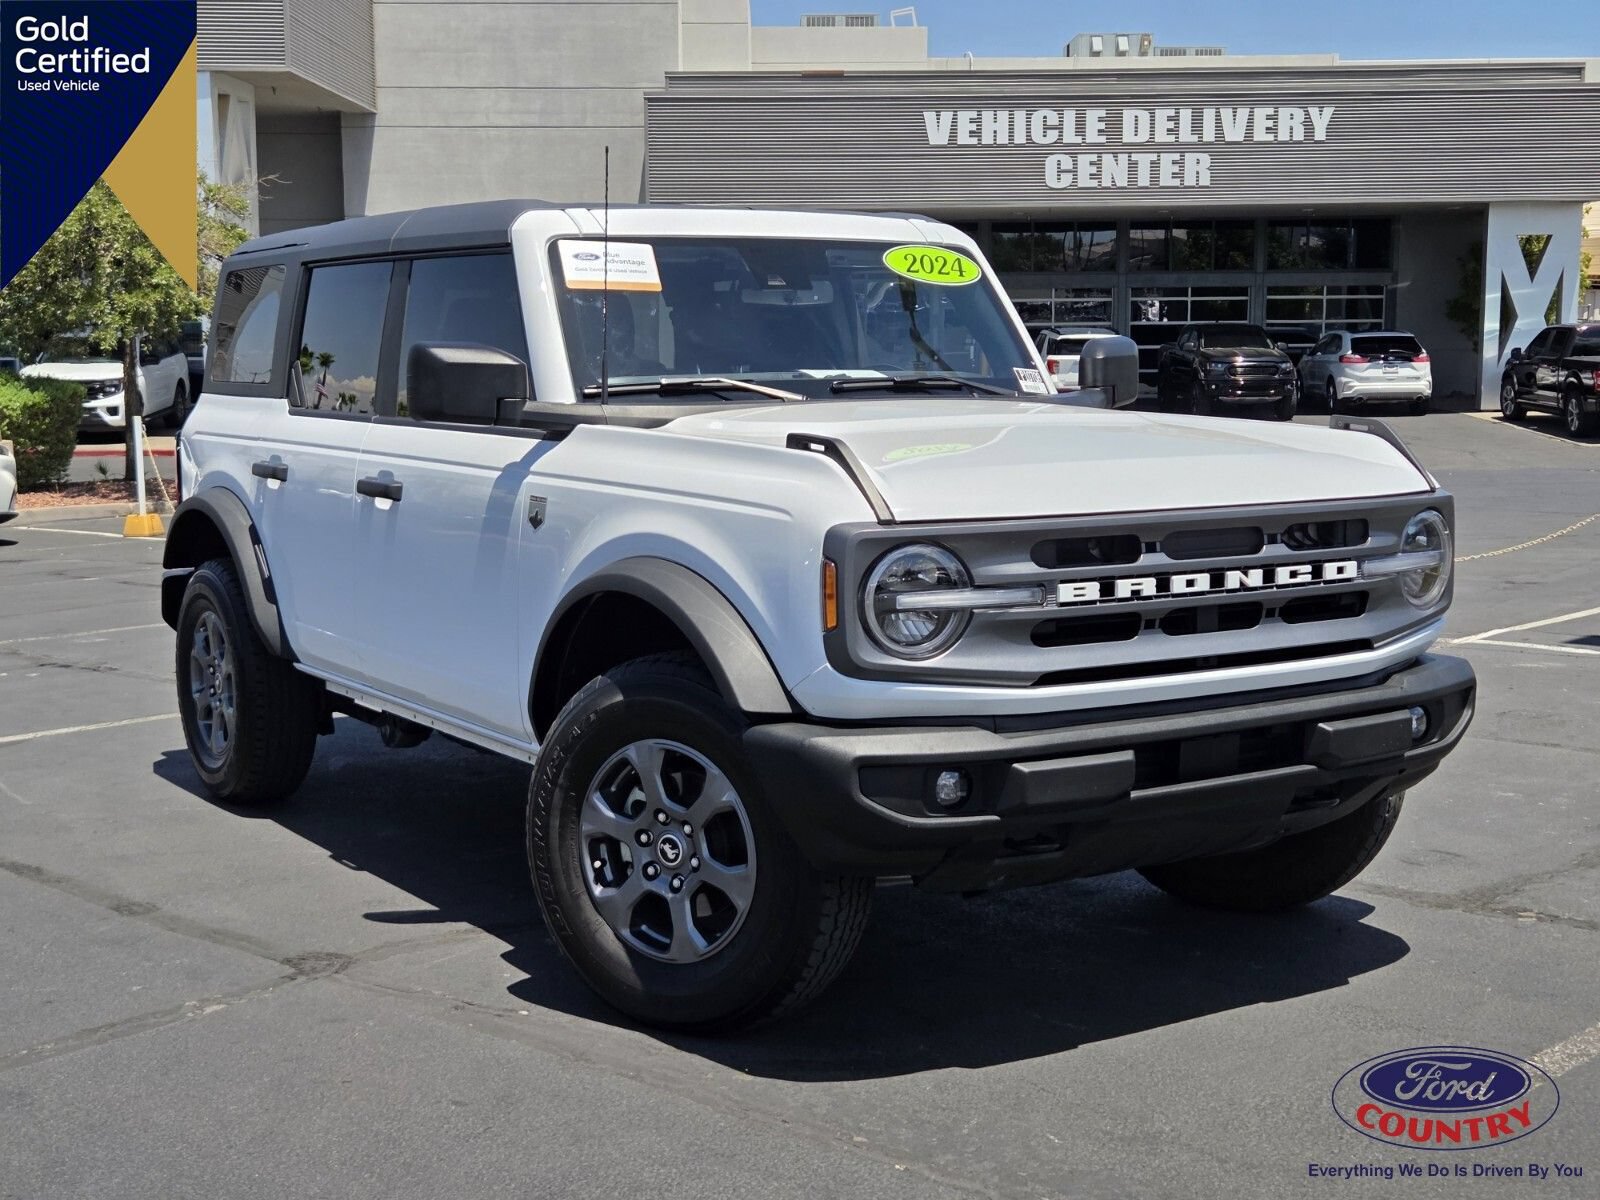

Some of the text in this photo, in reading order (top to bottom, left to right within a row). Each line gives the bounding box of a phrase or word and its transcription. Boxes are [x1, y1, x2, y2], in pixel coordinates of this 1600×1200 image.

[923, 106, 1336, 147] VEHICLE DELIVERY
[1044, 153, 1212, 189] CENTER
[903, 253, 967, 278] 2024
[1056, 560, 1358, 605] BRONCO
